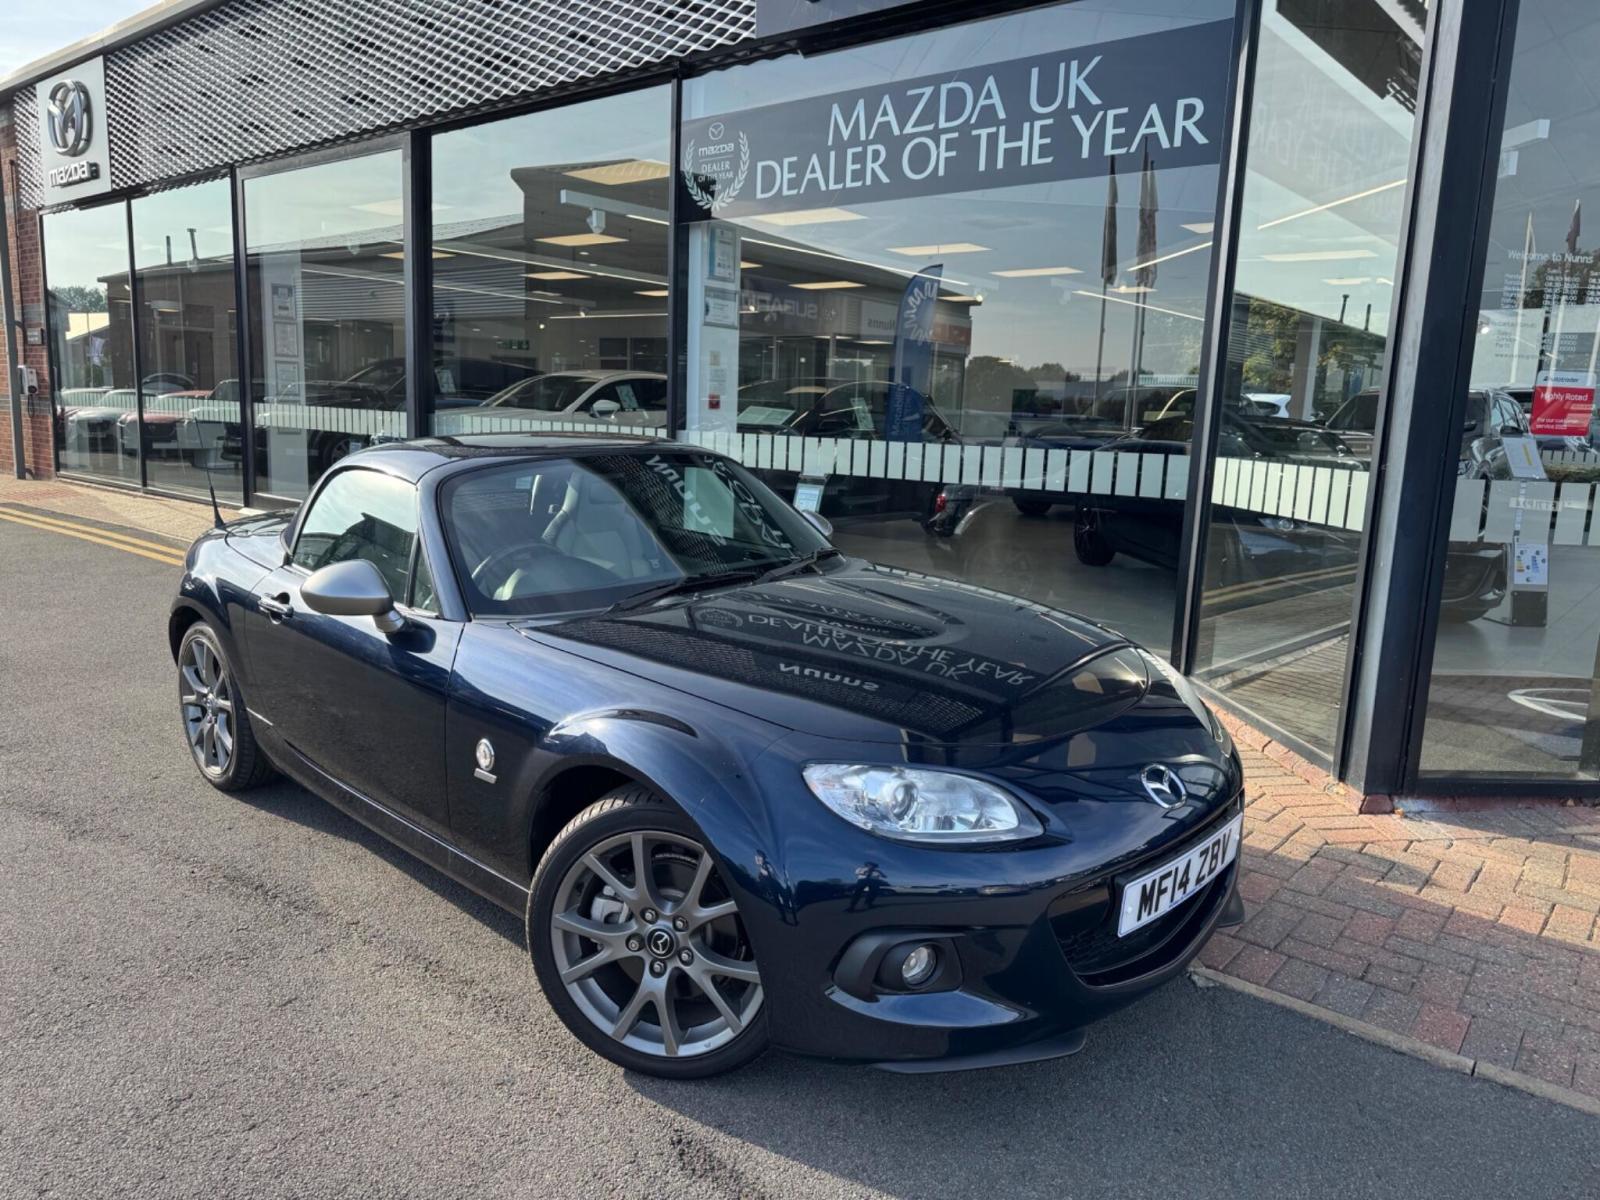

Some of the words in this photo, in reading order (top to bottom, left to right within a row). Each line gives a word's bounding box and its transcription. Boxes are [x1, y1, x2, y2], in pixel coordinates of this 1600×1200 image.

[828, 75, 1006, 146] MAZDA
[1029, 55, 1103, 114] UK
[698, 143, 735, 157] mazda
[756, 144, 891, 199] DEALER
[901, 132, 960, 181] OF
[971, 118, 1054, 172] THE
[1071, 97, 1210, 159] YEAR
[49, 160, 94, 188] mazda
[701, 161, 731, 174] DEALER
[719, 171, 734, 179] YEAR
[1508, 249, 1549, 261] Welome
[1552, 251, 1562, 262] to
[1564, 252, 1594, 264] Nunns
[1136, 858, 1192, 922] MF14
